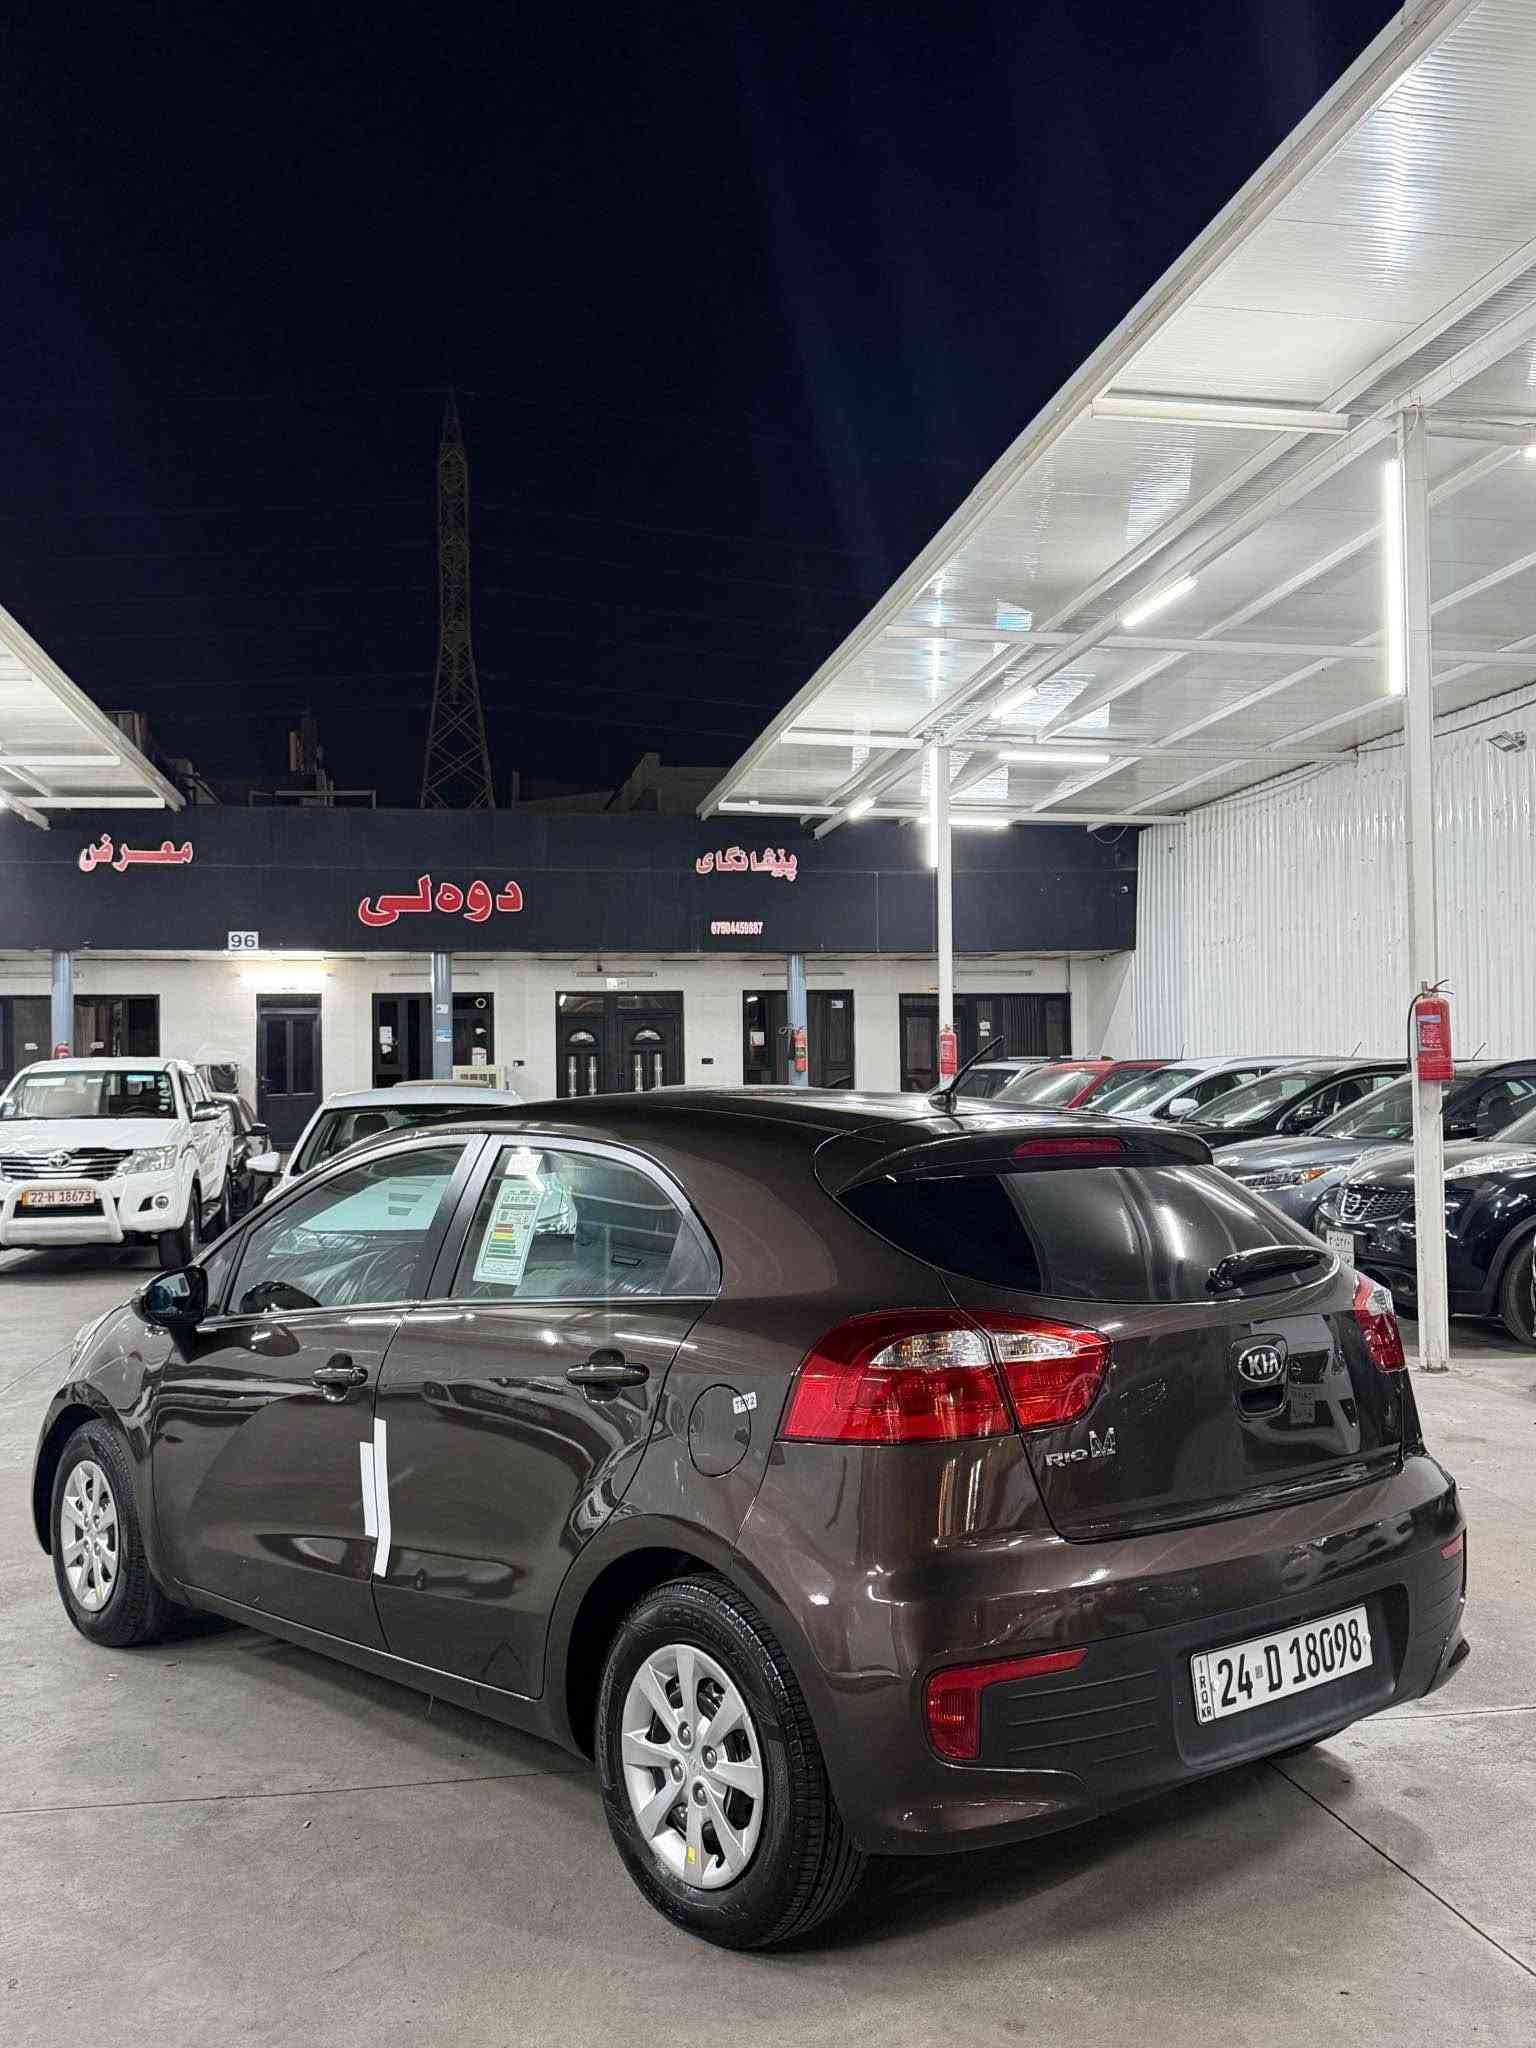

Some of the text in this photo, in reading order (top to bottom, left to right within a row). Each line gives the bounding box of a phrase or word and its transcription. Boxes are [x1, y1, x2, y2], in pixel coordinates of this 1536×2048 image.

[79, 833, 193, 872] معرض
[231, 934, 256, 948] 96
[1247, 1352, 1279, 1376] KIA
[1263, 1644, 1284, 1693] D
[1289, 1618, 1363, 1685] 18098
[1201, 1705, 1213, 1719] KR
